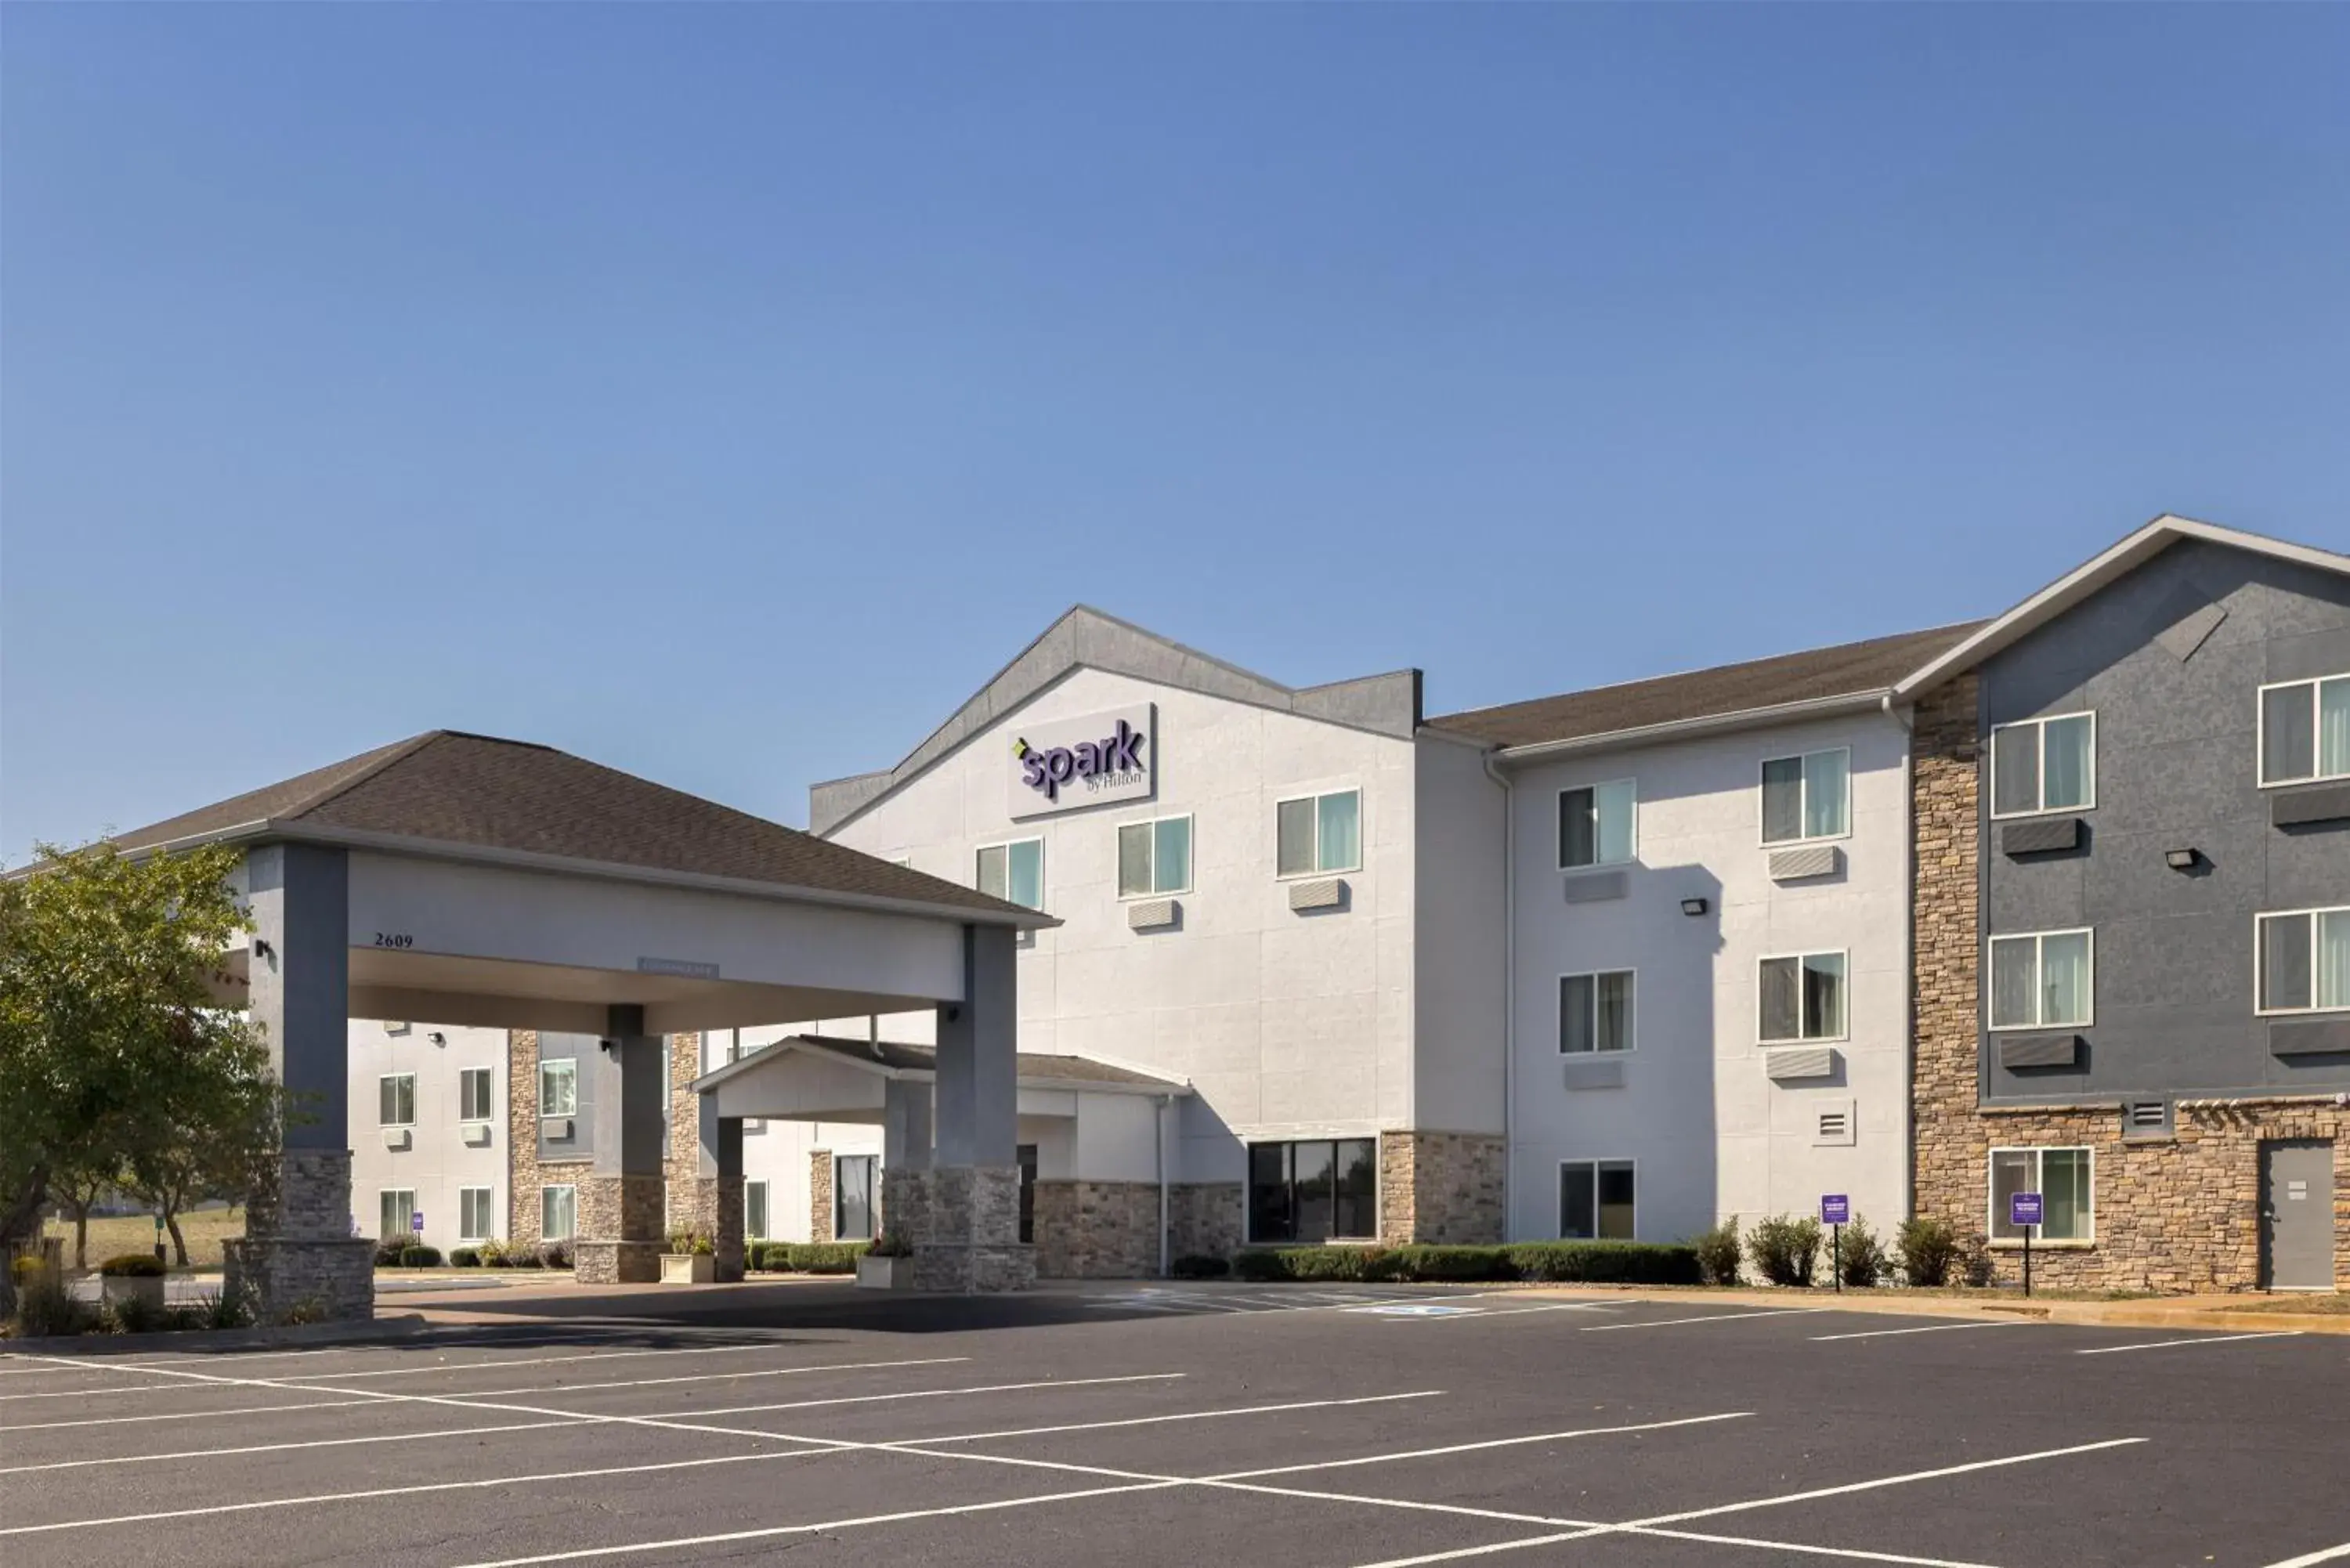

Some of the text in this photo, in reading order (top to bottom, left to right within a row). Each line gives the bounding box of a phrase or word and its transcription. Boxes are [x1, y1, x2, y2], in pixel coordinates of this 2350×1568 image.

[1022, 719, 1145, 802] spark
[1087, 772, 1141, 793] by Hilton
[375, 932, 413, 948] 2609
